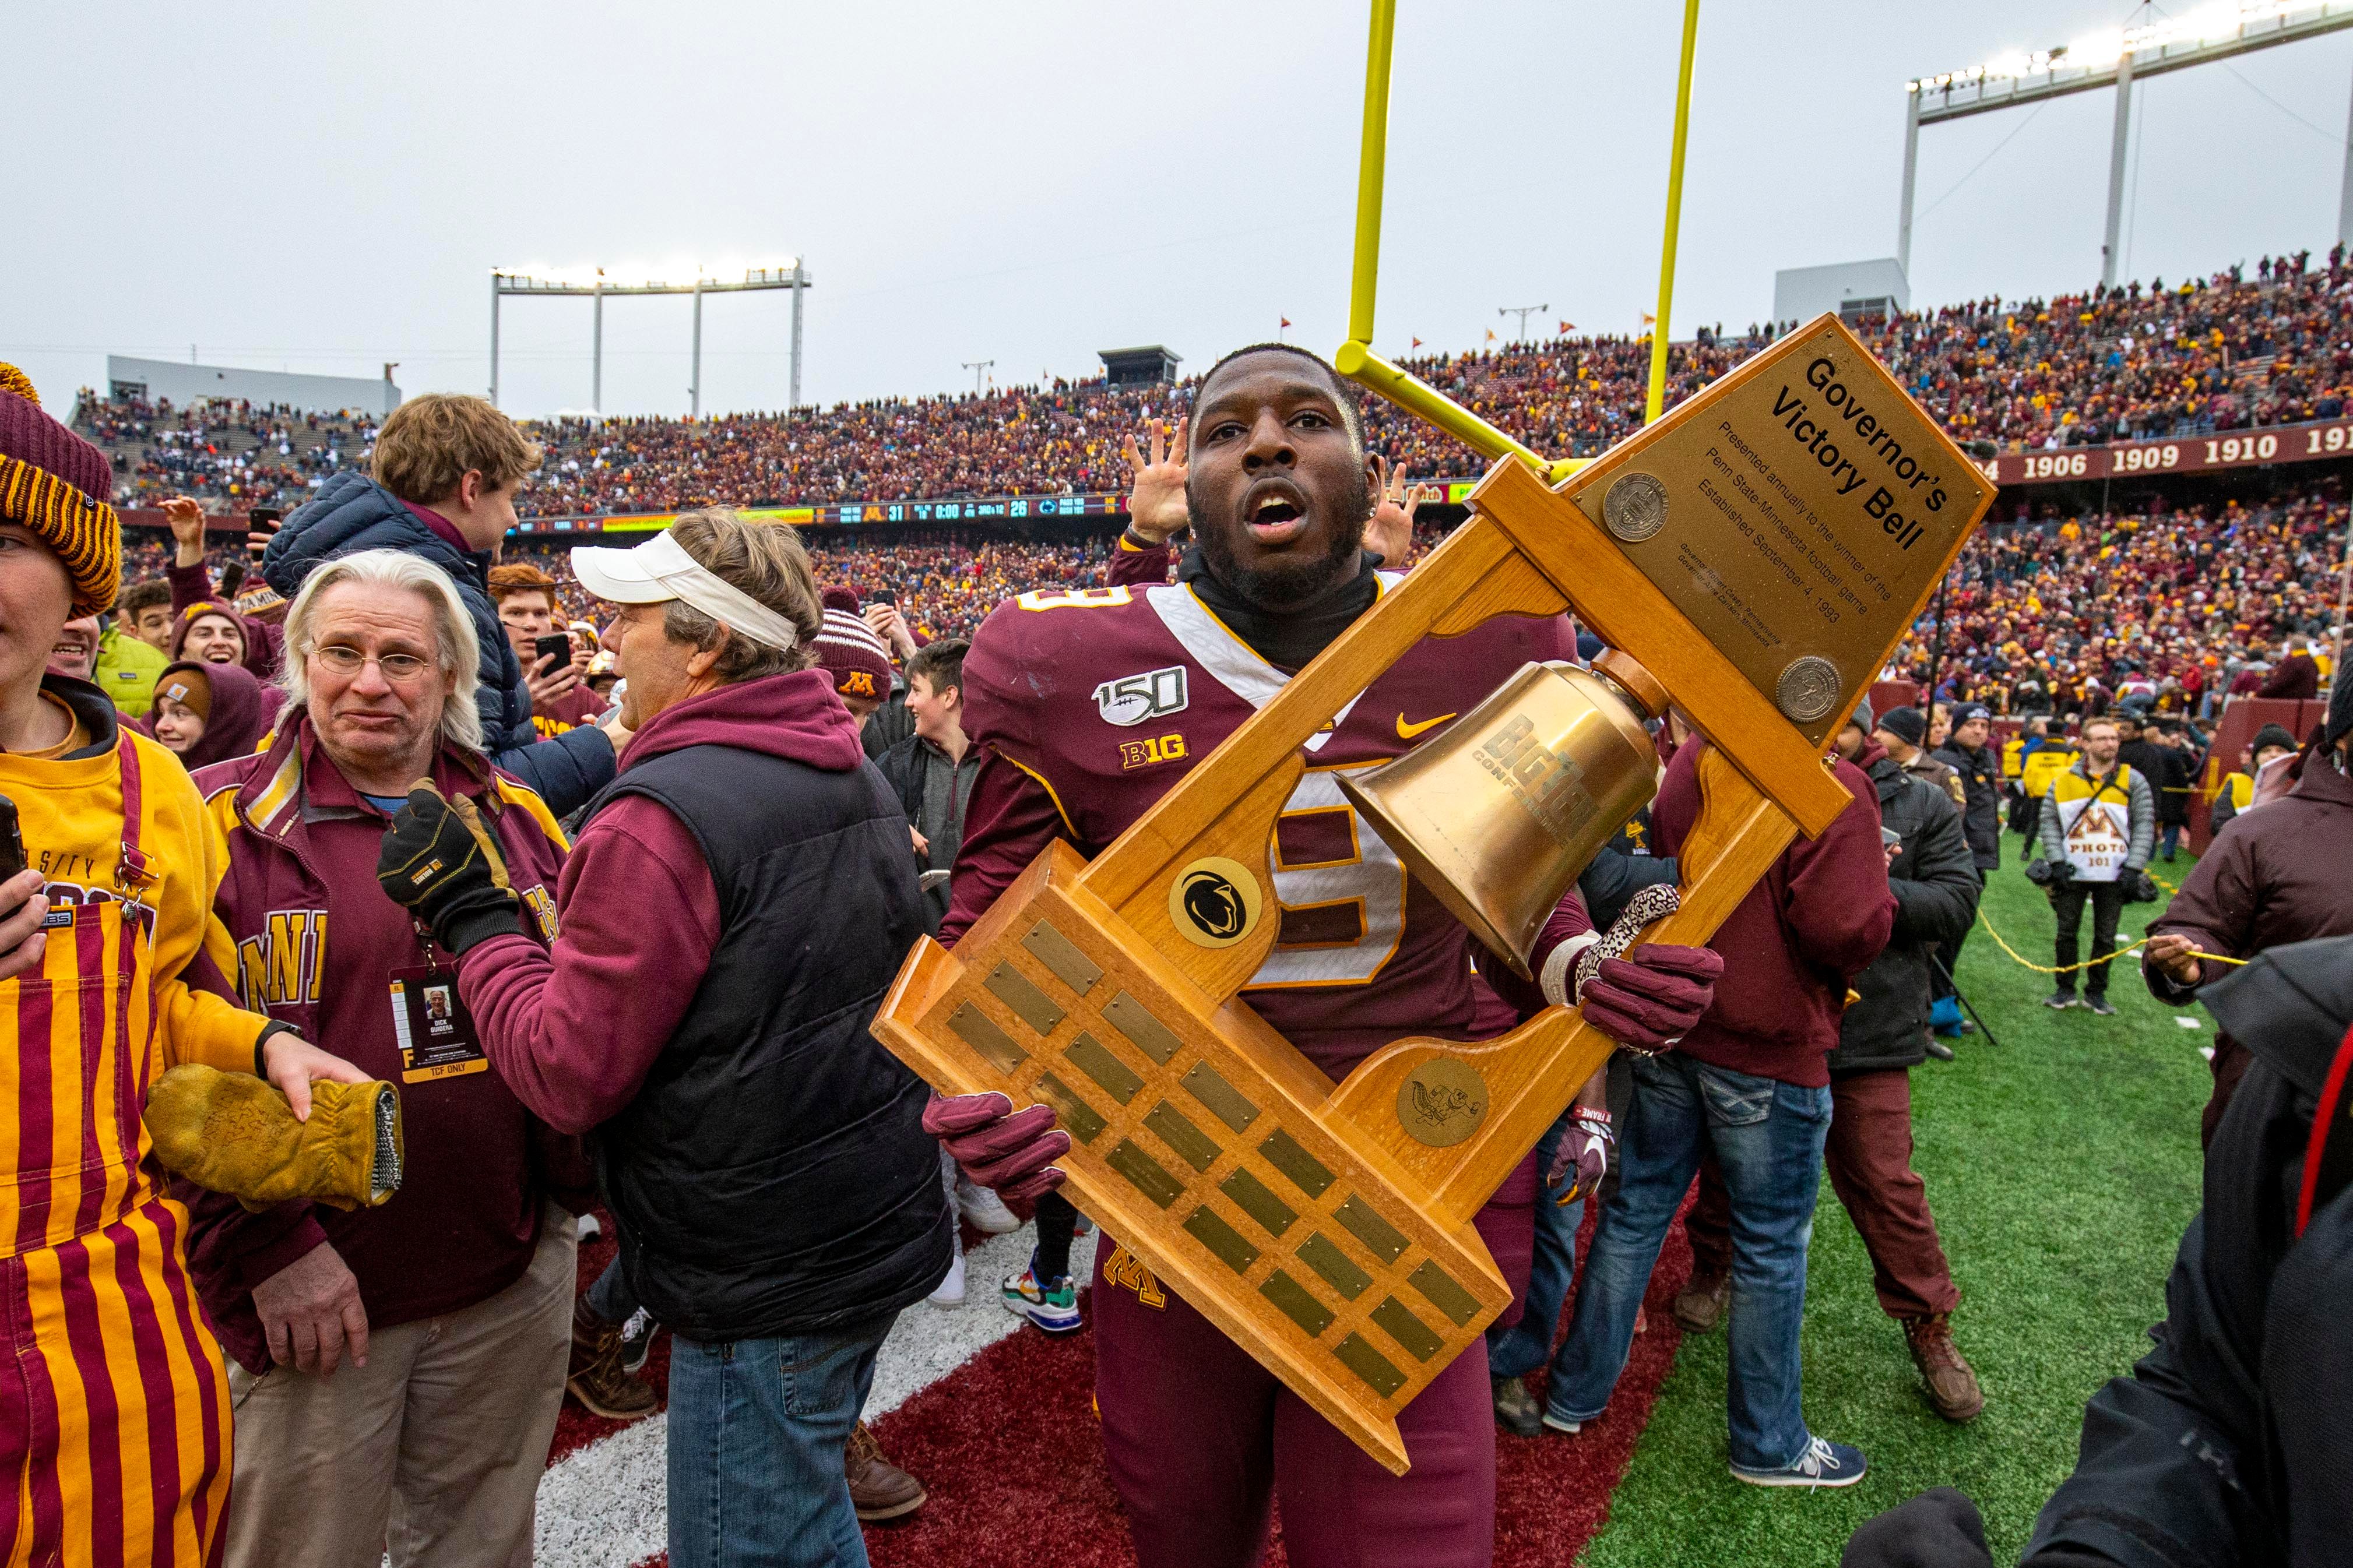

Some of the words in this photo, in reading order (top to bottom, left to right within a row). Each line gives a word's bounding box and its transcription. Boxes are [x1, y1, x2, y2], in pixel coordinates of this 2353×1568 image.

[1806, 358, 1947, 513] Governor's
[2112, 445, 2180, 473] 1909
[2204, 435, 2278, 464] 1910
[1772, 385, 1867, 495] Victory
[1863, 487, 1924, 551] Bell
[2024, 454, 2087, 480] 1906
[888, 505, 903, 521] 31
[935, 504, 959, 519] 0:00
[1010, 500, 1028, 517] 26
[1718, 421, 1770, 474] Presented
[1767, 473, 1808, 515] annually
[1806, 512, 1817, 525] to
[1817, 522, 1834, 542] the
[1833, 540, 1865, 573] winner
[1864, 573, 1879, 586] of
[1874, 582, 1891, 601] the
[1705, 448, 1733, 478] Penn
[1733, 474, 1807, 554] State-Minnesota
[1806, 550, 1844, 588] football
[1838, 587, 1867, 615] game
[1698, 478, 1756, 537] Established
[1753, 534, 1805, 587] September
[1803, 587, 1813, 600] 4,
[1815, 597, 1840, 623] 1993
[1678, 555, 1705, 582] Governor
[1703, 582, 1719, 597] Arne
[1740, 618, 1770, 647] Minnesota
[1680, 543, 1708, 570] Governor
[1706, 569, 1727, 590] Robert
[1744, 607, 1781, 644] Pennsylvania
[1099, 668, 1186, 723] 150
[2070, 843, 2126, 854] PHOTO
[2089, 857, 2109, 868] 101
[430, 1024, 453, 1033] GUIDERA
[402, 1049, 414, 1069] F
[430, 1067, 445, 1077] TCF
[447, 1063, 466, 1074] ONLY
[1582, 1108, 1606, 1122] FRAME
